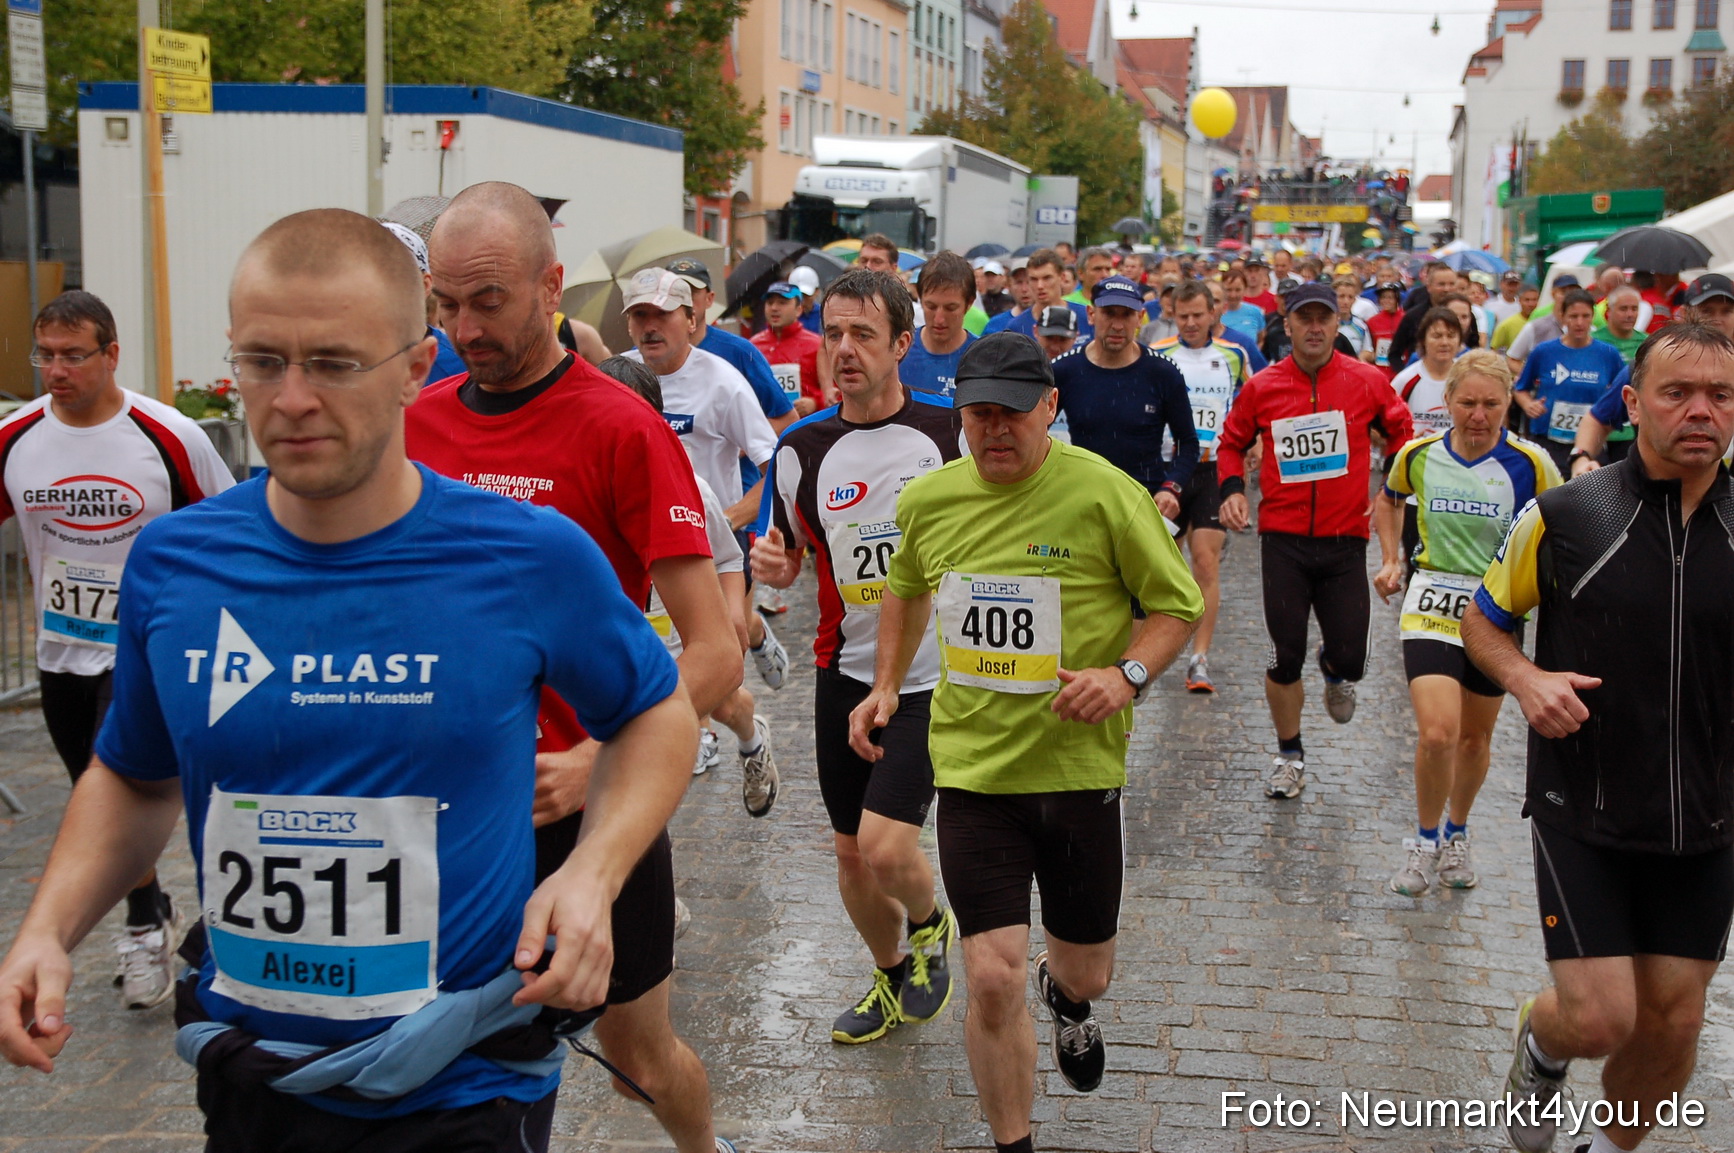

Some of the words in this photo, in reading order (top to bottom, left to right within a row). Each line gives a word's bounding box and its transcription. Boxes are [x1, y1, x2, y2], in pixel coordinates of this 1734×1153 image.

[664, 419, 686, 430] ER
[1282, 428, 1338, 459] 3057
[1300, 462, 1326, 473] Erwin
[462, 473, 476, 484] 11.
[478, 473, 554, 491] NEUMARKTER
[23, 489, 117, 503] GERHART
[828, 487, 855, 502] tkn
[1434, 487, 1476, 498] TEAM
[1430, 498, 1499, 517] BOCK
[41, 524, 57, 537] Das
[58, 533, 101, 546] sportliche
[103, 525, 143, 545] Autohaus
[972, 582, 1020, 595] BOCK
[51, 579, 119, 620] 3177
[1418, 588, 1470, 620] 646
[67, 620, 106, 638] Rainer
[961, 606, 1034, 650] 408
[1421, 618, 1457, 634] Marion
[292, 653, 439, 683] PLAST
[976, 657, 1016, 676] Josef
[290, 691, 347, 706] Systeme
[349, 692, 362, 704] in
[364, 692, 434, 704] Kunststoff
[259, 811, 357, 832] BOCK
[219, 851, 401, 936] 2511
[262, 952, 355, 994] Alexej
